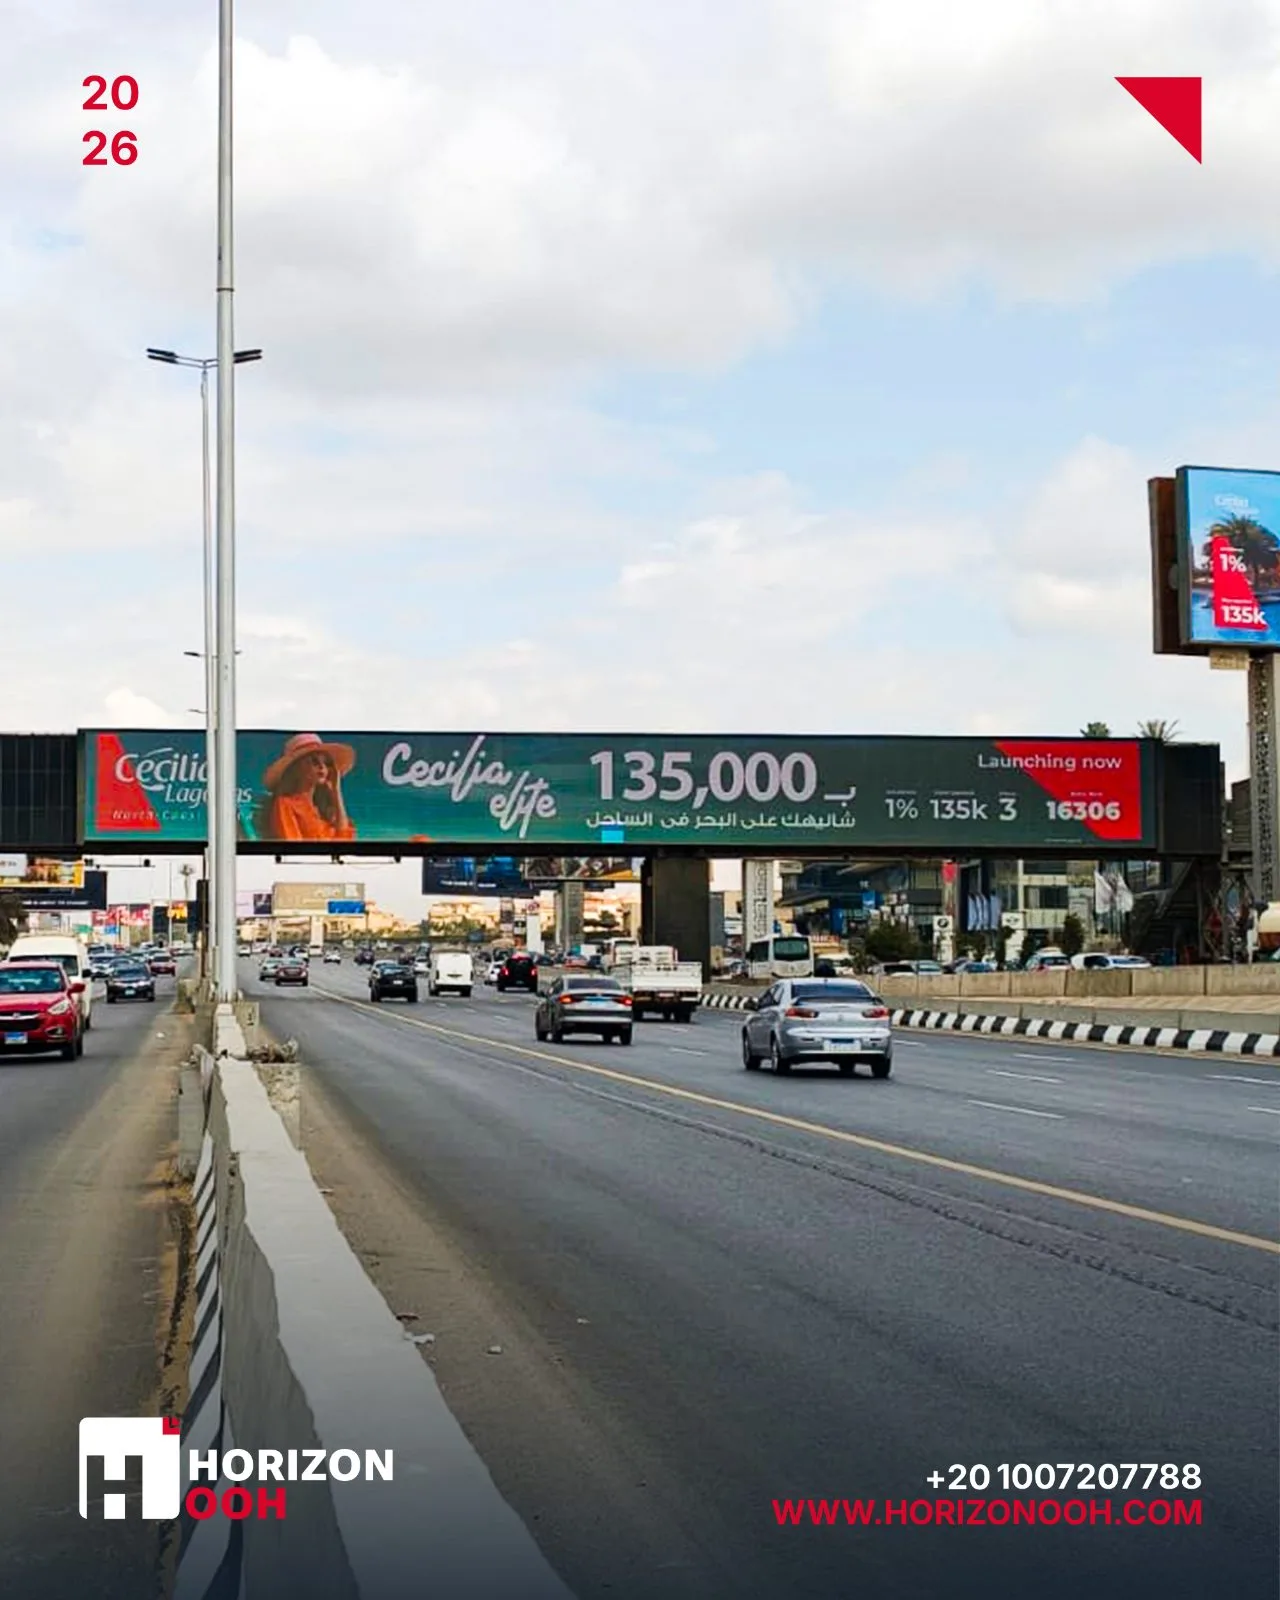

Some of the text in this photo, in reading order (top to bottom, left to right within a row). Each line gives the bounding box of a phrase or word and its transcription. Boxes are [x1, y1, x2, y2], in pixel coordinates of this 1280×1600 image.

[1219, 553, 1248, 573] 1%
[1221, 604, 1267, 625] 135k
[381, 734, 513, 803] Cecilia
[977, 753, 1122, 773] Launching now
[589, 750, 818, 810] 135,000
[165, 783, 253, 809] Lagns
[884, 798, 919, 819] 1%
[929, 798, 989, 820] 135k
[998, 798, 1018, 821] 3
[1045, 801, 1121, 821] 16306
[586, 811, 654, 829] الساحل
[692, 811, 737, 831] البحر
[781, 810, 857, 830] شاليهك
